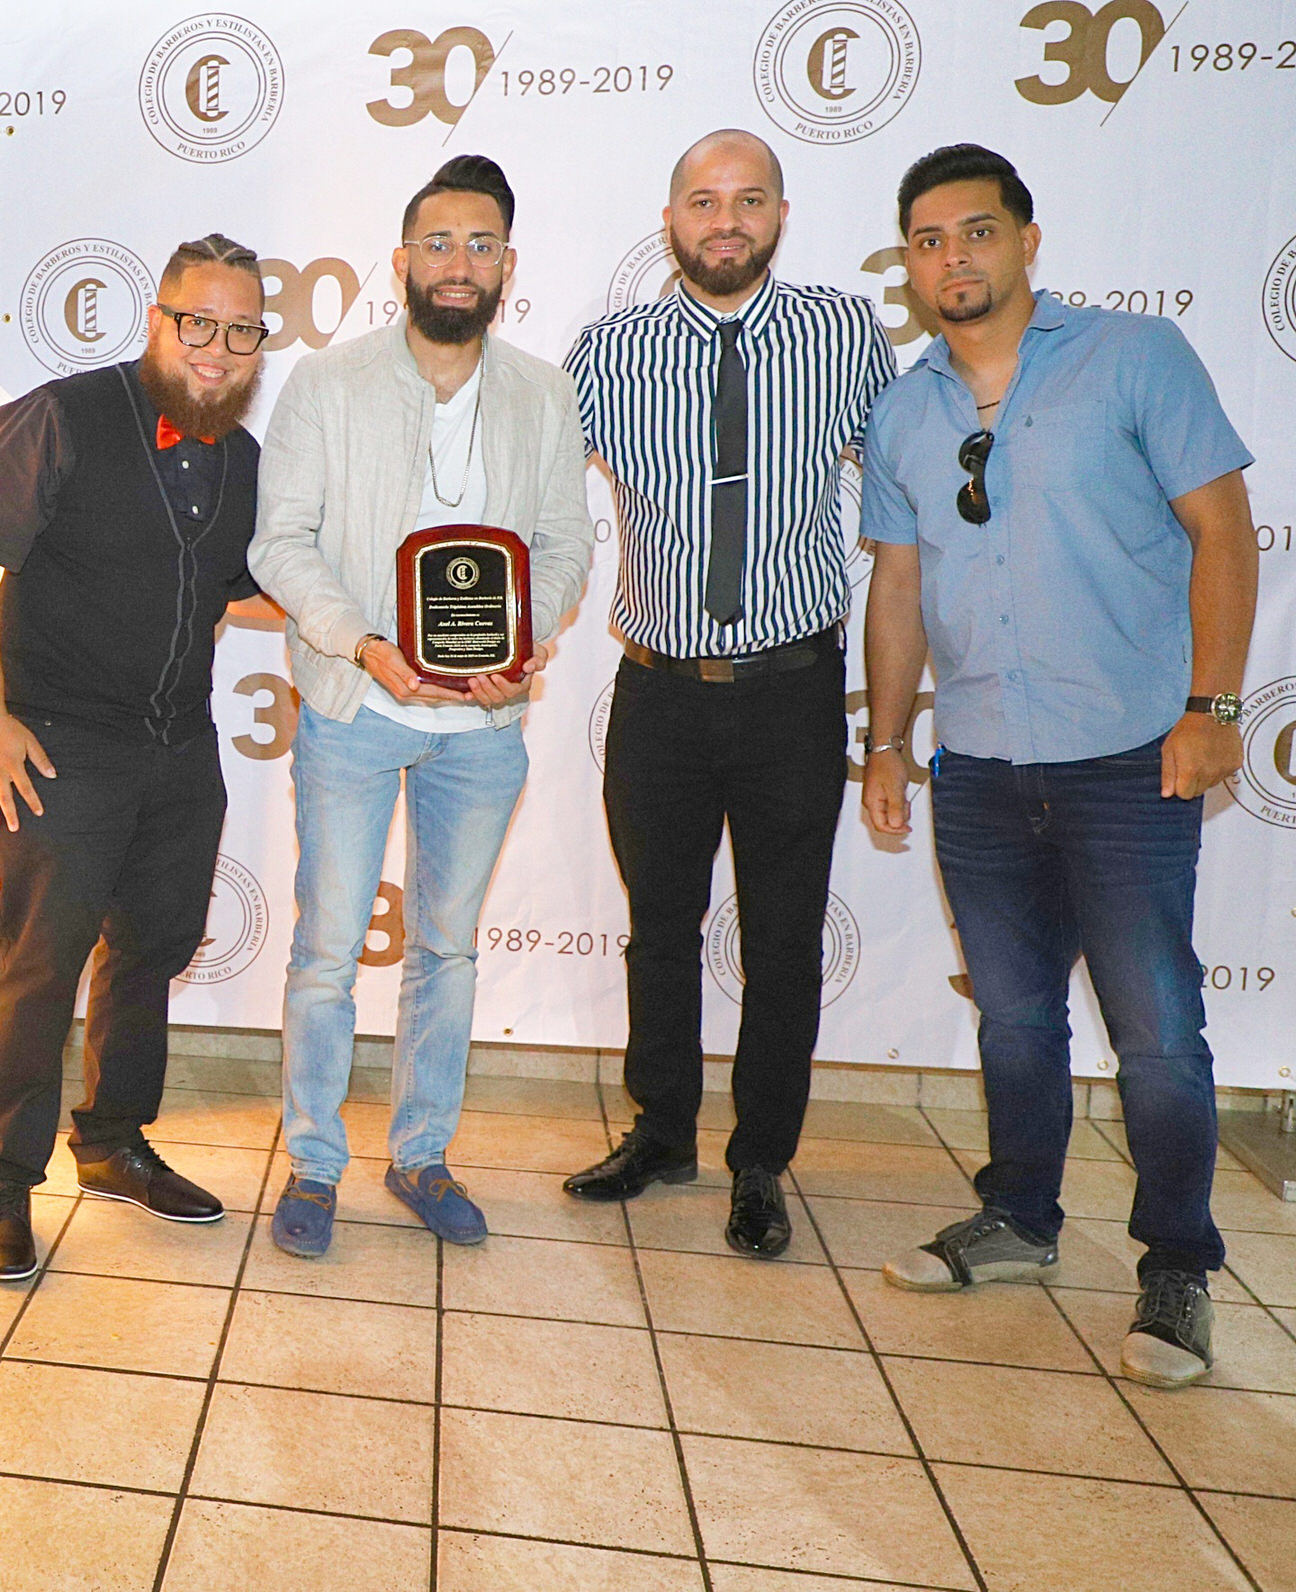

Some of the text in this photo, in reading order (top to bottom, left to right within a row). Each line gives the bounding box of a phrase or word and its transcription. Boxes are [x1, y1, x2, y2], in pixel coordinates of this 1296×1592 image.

[206, 19, 213, 28] Y
[776, 0, 822, 31] BARBER
[157, 22, 204, 60] BARBEROS
[216, 19, 265, 52] ESTILISTAS
[766, 33, 777, 48] DE
[898, 24, 912, 40] EN
[149, 60, 159, 74] DE
[263, 51, 276, 66] EN
[1170, 41, 1296, 73] 1989-2
[501, 64, 674, 97] 1989-2019
[760, 51, 775, 102] COLEGIO
[144, 76, 159, 125] COLEGIO
[795, 121, 873, 140] PUERTO RICO
[176, 141, 246, 159] PUERTO RICO
[36, 246, 81, 280] BARBEROS
[83, 244, 90, 252] Y
[93, 244, 142, 276] ESTILISTAS
[618, 272, 629, 286] DE
[627, 236, 668, 270] BARBER
[29, 281, 39, 296] DE
[139, 277, 150, 291] EN
[1270, 259, 1290, 331] COLEGIO DE
[25, 296, 39, 344] COLEGIO
[1244, 682, 1296, 717] BARBERO
[1260, 805, 1296, 824] PUERT
[249, 888, 260, 902] EN
[712, 930, 726, 976] COLEGIO
[208, 966, 232, 980] RICO
